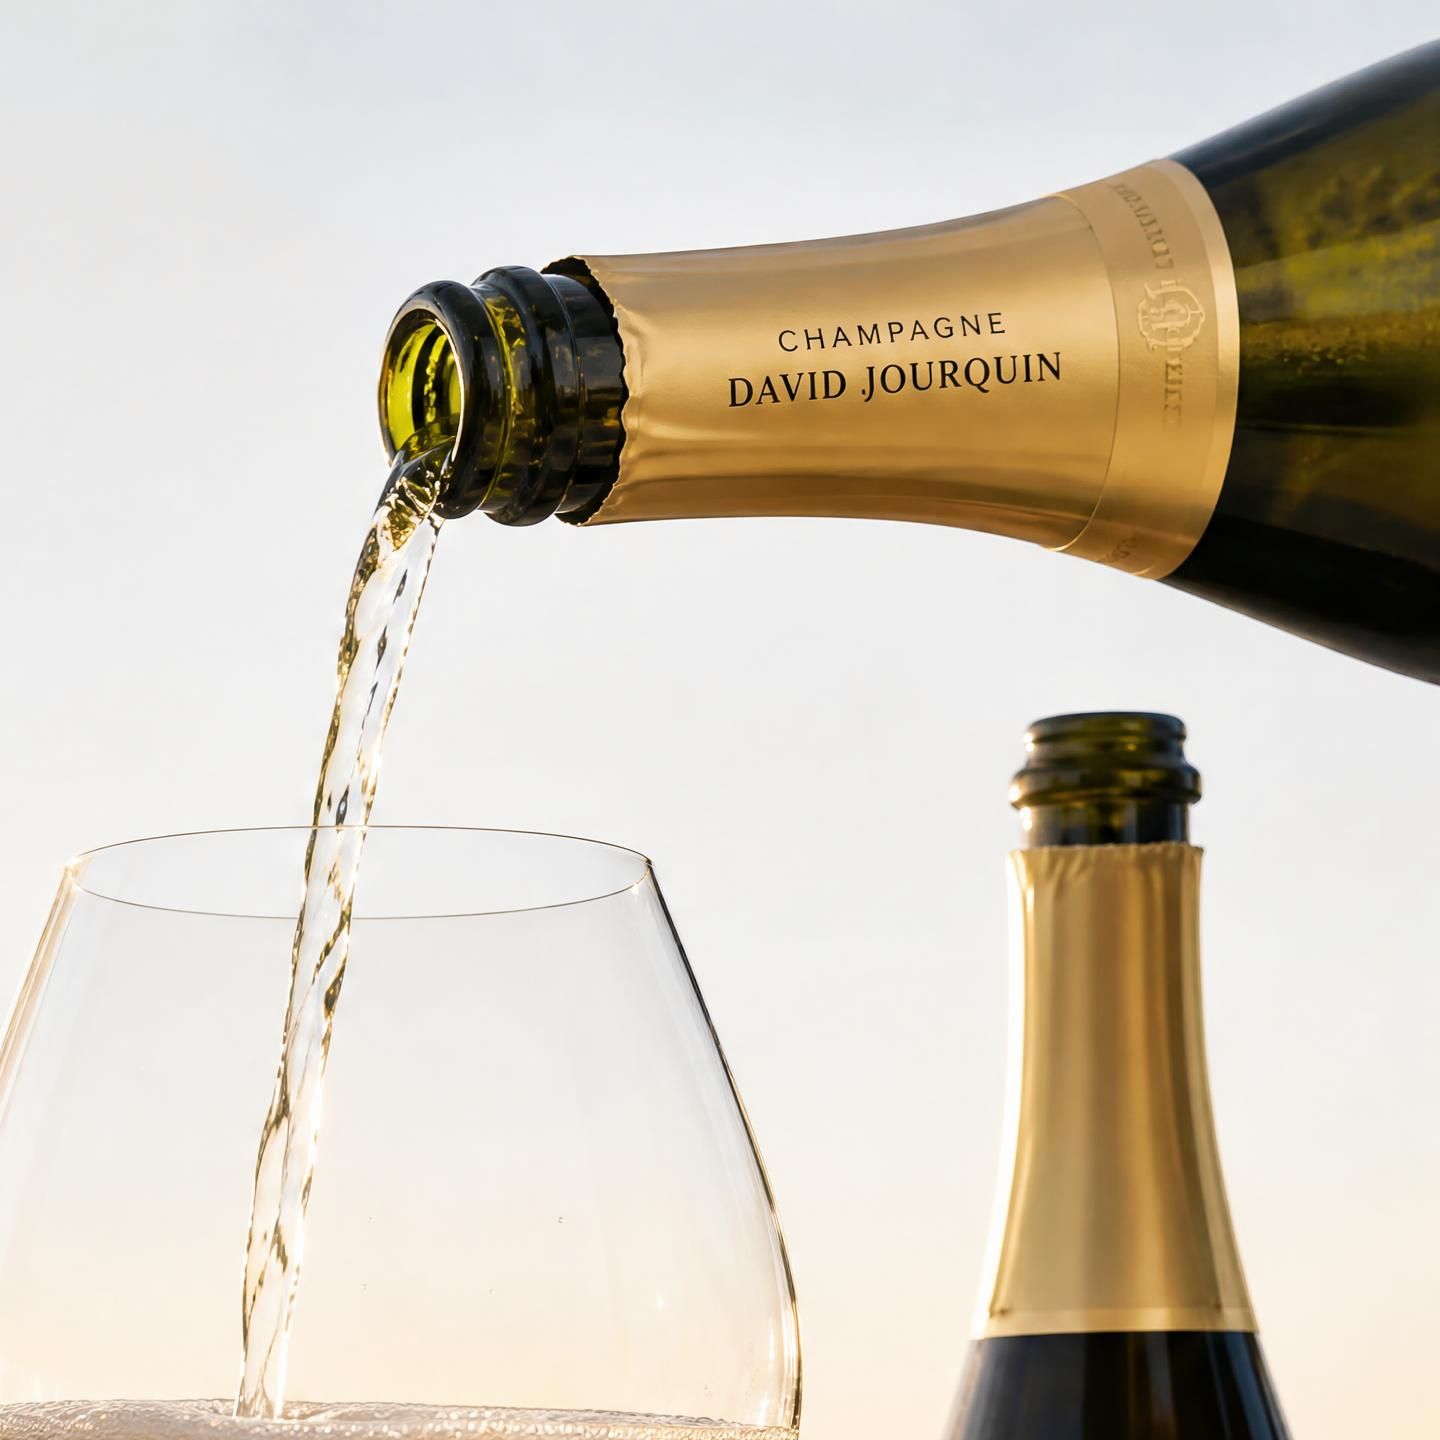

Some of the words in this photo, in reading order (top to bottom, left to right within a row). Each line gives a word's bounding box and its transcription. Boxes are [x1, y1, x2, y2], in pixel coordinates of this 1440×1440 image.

[777, 311, 1007, 353] CHAMPAGNE
[727, 369, 848, 408] DAVID
[861, 351, 1062, 403] JOURQUIN
